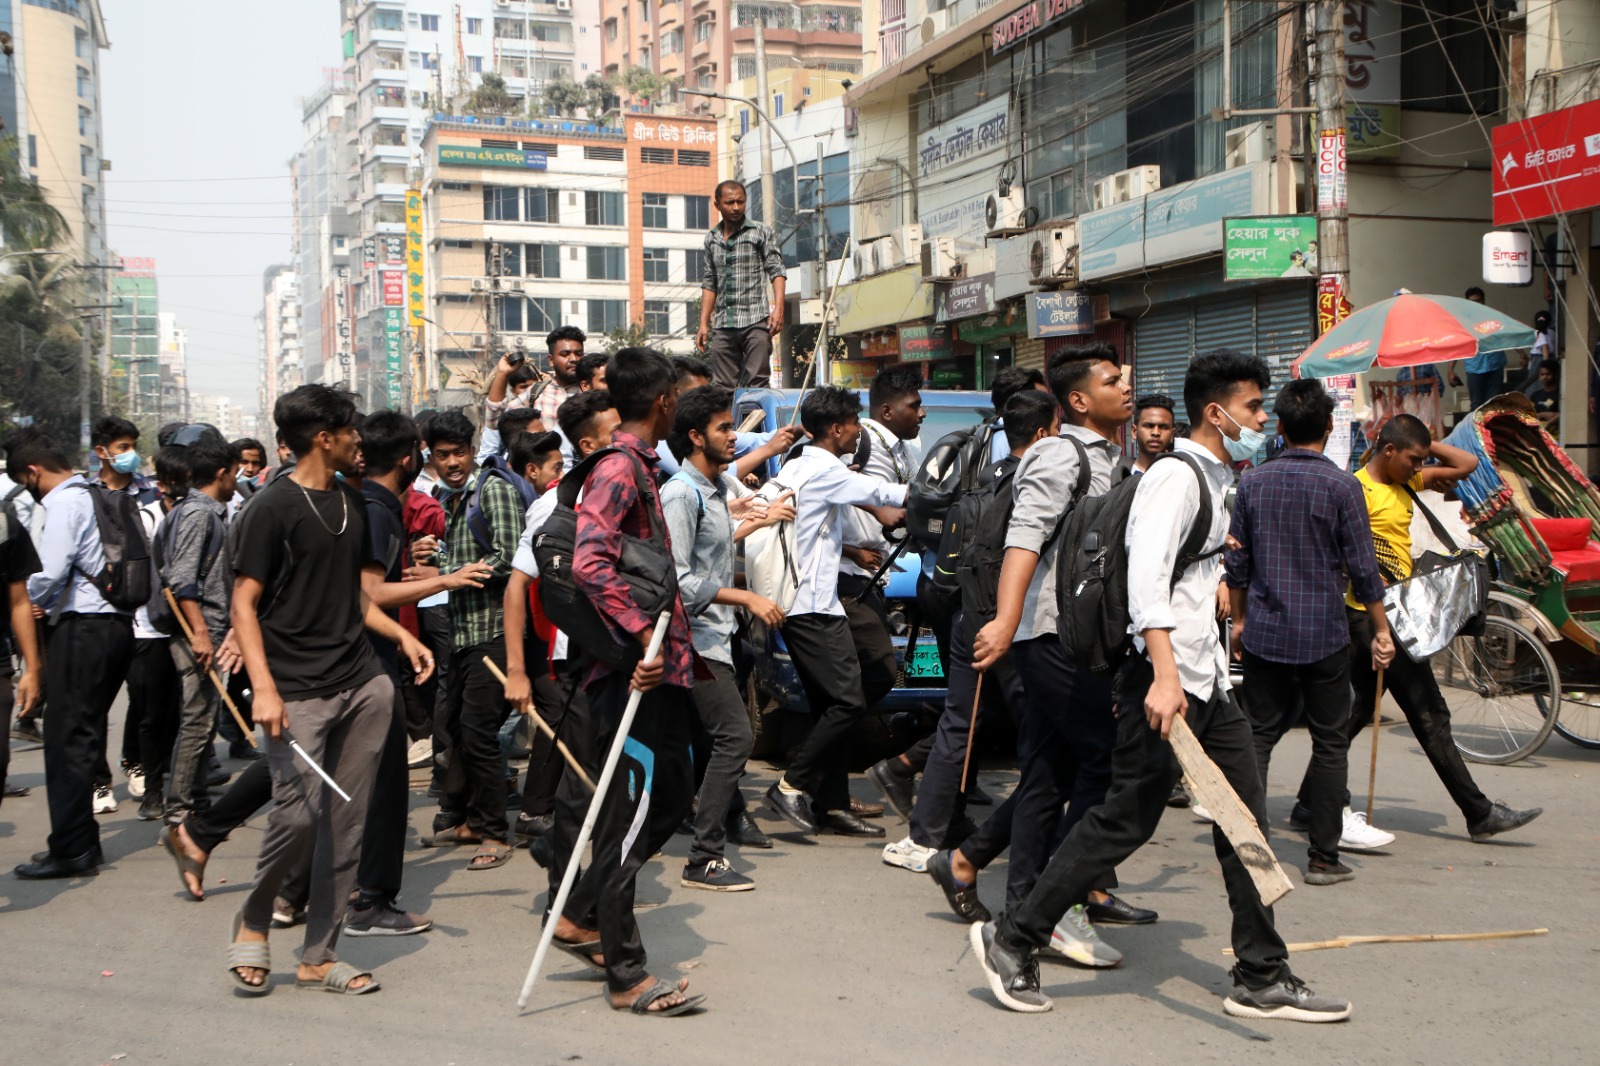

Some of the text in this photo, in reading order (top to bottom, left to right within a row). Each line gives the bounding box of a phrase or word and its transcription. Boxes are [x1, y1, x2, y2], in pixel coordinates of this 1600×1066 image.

[993, 0, 1084, 50] SUDEEN DEN
[633, 122, 717, 144] গ্রীন ভিউ ক্লিনিক
[945, 125, 974, 164] ডেন্টাল
[978, 112, 1006, 150] কেয়ার
[1320, 138, 1334, 174] UCC
[1525, 144, 1576, 168] সিটি ব্যাংক
[1227, 226, 1269, 241] হেয়ার
[1273, 226, 1302, 242] লুক
[1227, 246, 1268, 263] সেলুন
[1493, 249, 1528, 261] smart
[949, 282, 983, 298] হেয়ার লুক
[953, 296, 978, 310] সেলুন
[1036, 293, 1063, 309] বৈশাখী
[1050, 307, 1080, 323] টেইলার্স
